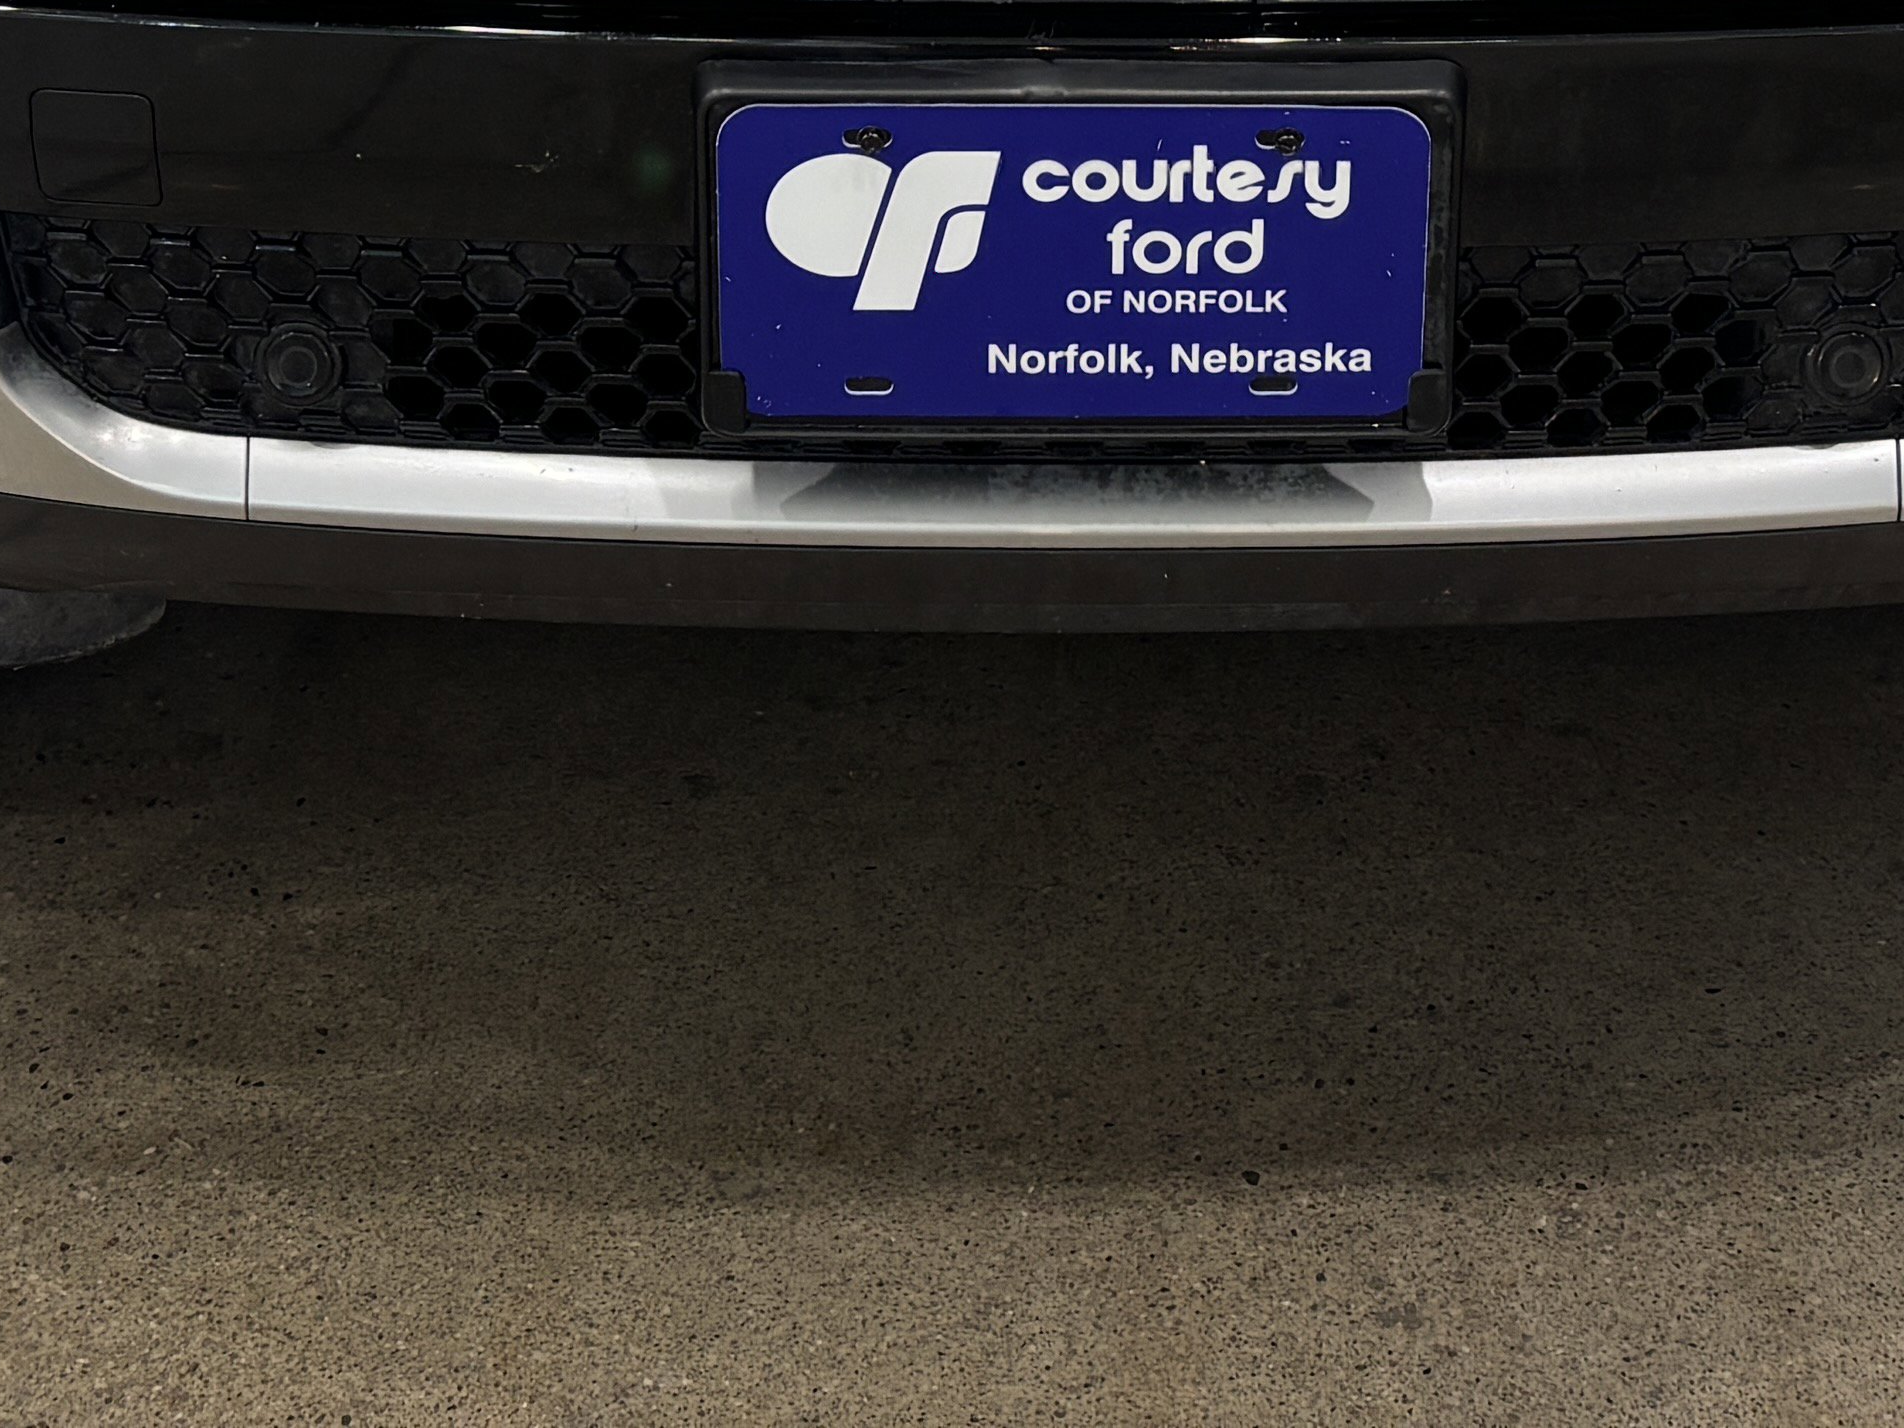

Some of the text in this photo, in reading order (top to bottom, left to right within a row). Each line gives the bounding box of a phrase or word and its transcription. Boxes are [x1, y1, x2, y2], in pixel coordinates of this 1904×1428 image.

[1022, 144, 1351, 220] courtesy
[1106, 218, 1264, 275] ford
[1065, 289, 1288, 314] OF NORFOLK
[987, 342, 1372, 379] Norfolk, Nebraska
